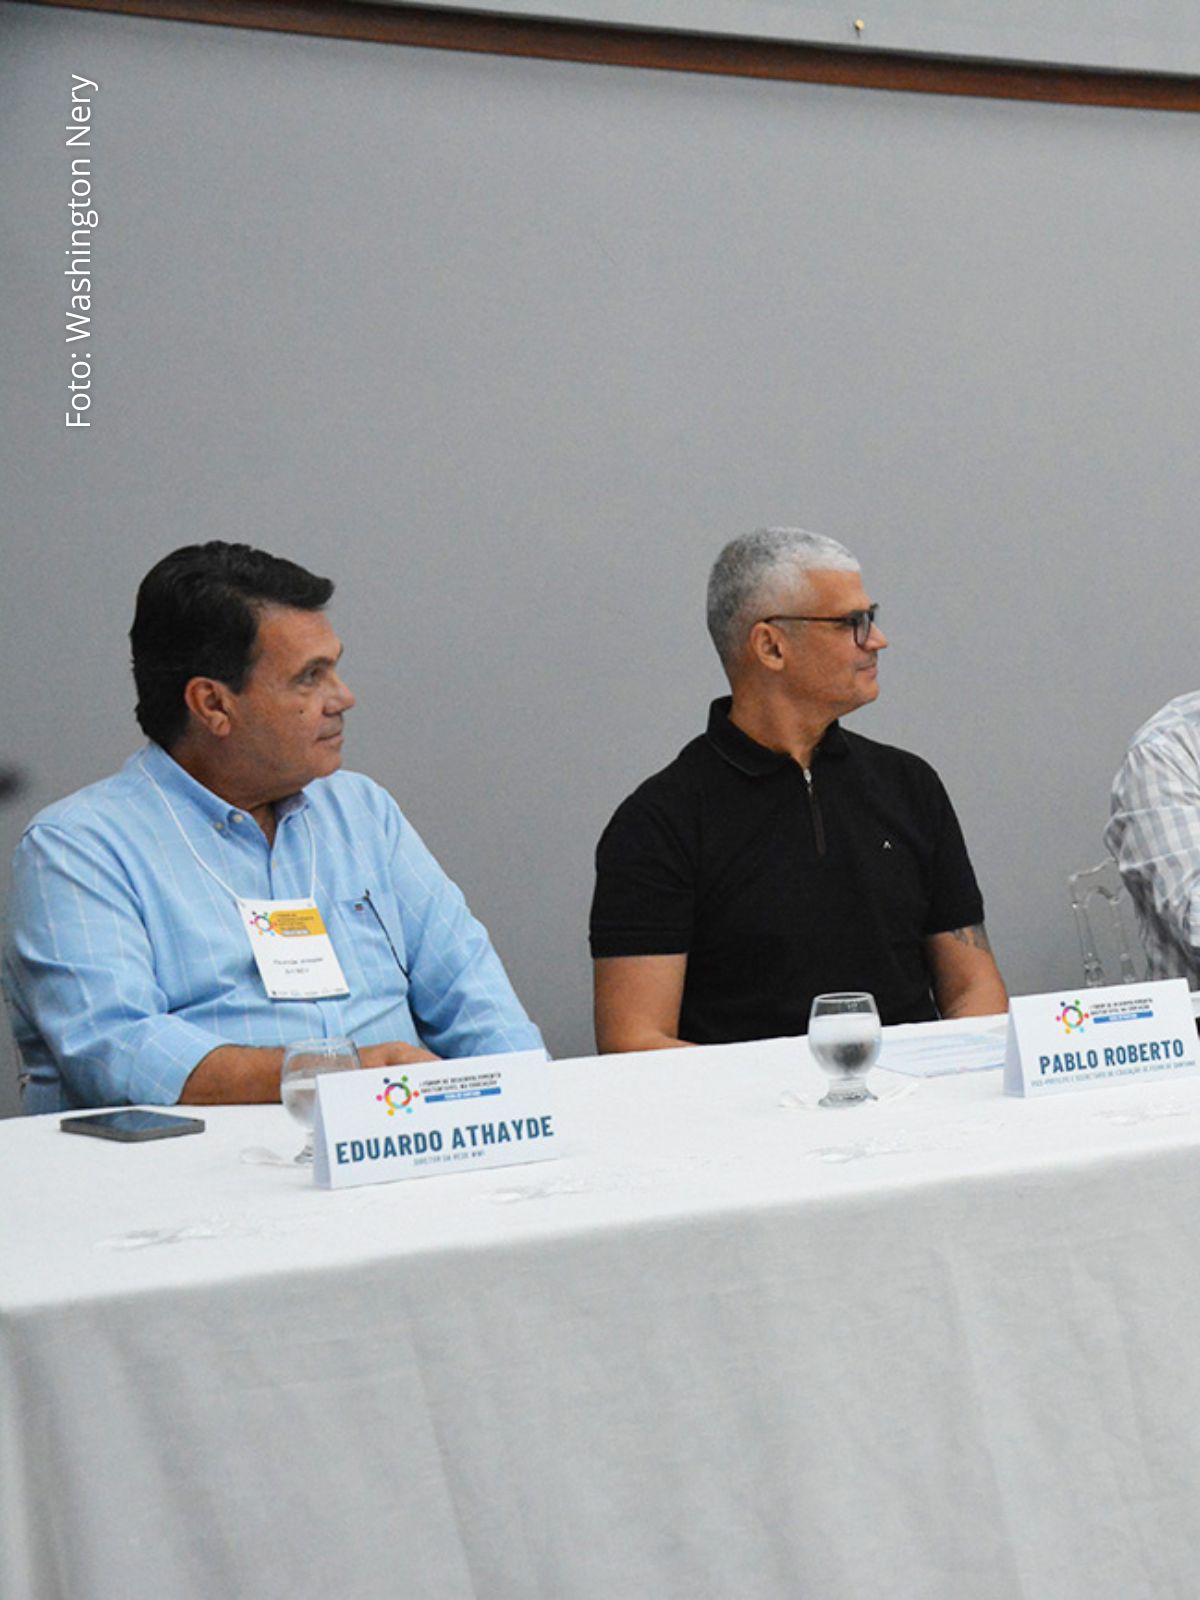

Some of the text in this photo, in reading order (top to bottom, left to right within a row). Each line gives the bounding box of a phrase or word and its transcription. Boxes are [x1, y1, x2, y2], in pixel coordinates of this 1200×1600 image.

[1039, 1049, 1099, 1075] PABLO
[1104, 1039, 1185, 1067] ROBERTO
[335, 1115, 555, 1165] EDUARDO ATHAYDE
